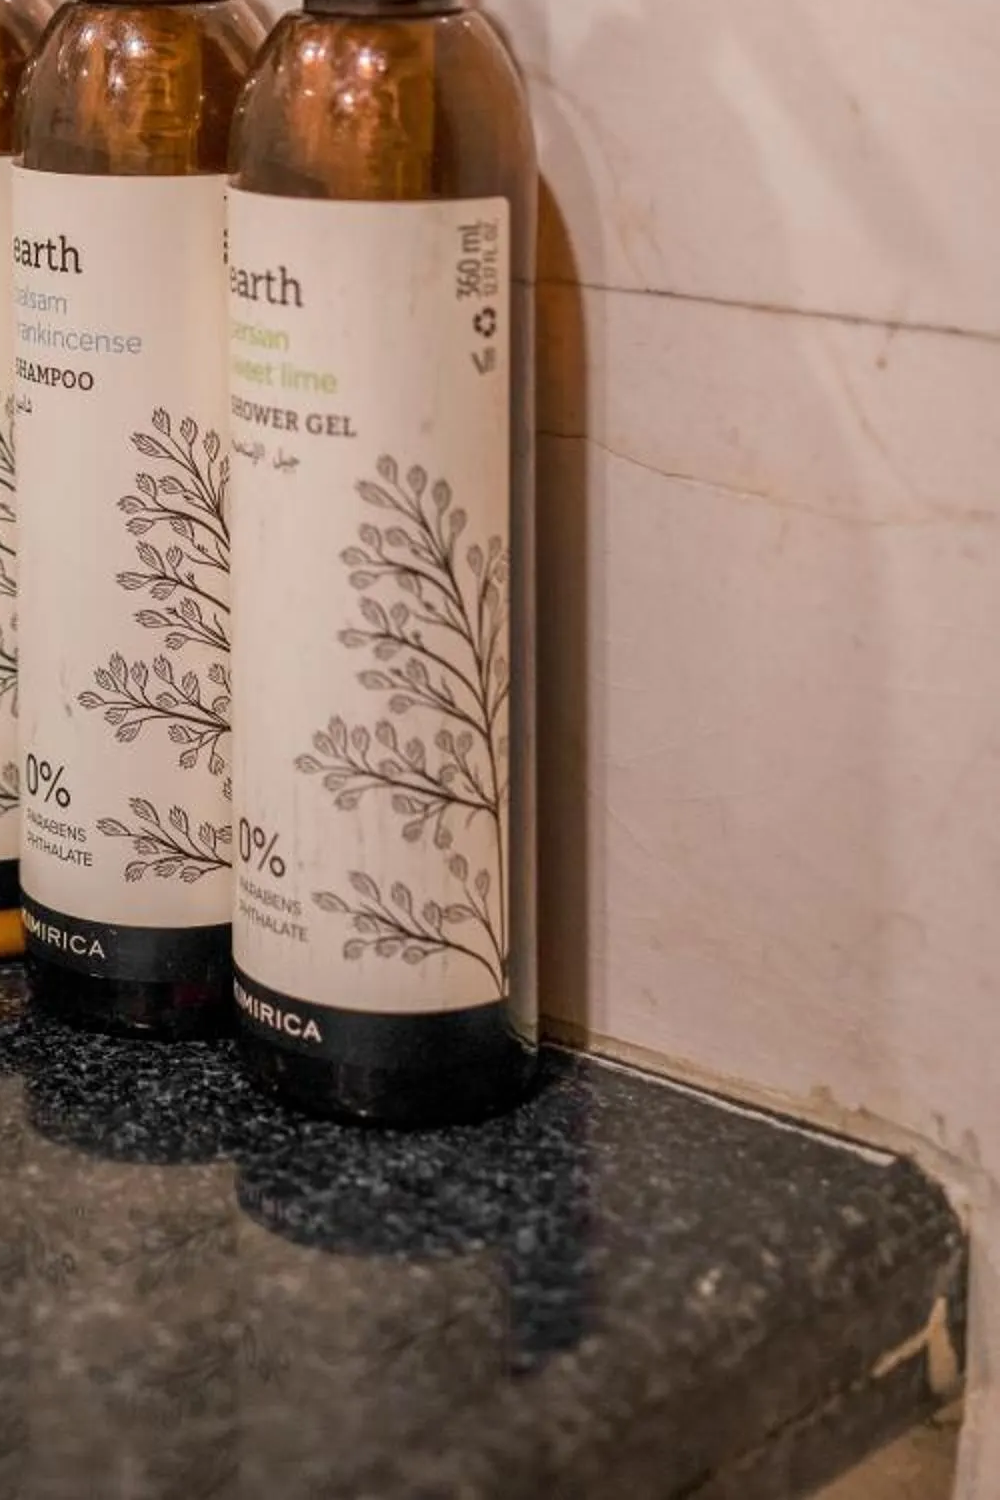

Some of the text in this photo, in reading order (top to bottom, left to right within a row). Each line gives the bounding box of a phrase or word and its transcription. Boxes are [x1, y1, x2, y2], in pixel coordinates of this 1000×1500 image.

[13, 234, 83, 274] earth
[456, 258, 481, 300] 360
[281, 362, 338, 394] lime
[305, 412, 358, 438] GEL
[26, 753, 71, 808] 0%
[240, 817, 286, 877] 0%
